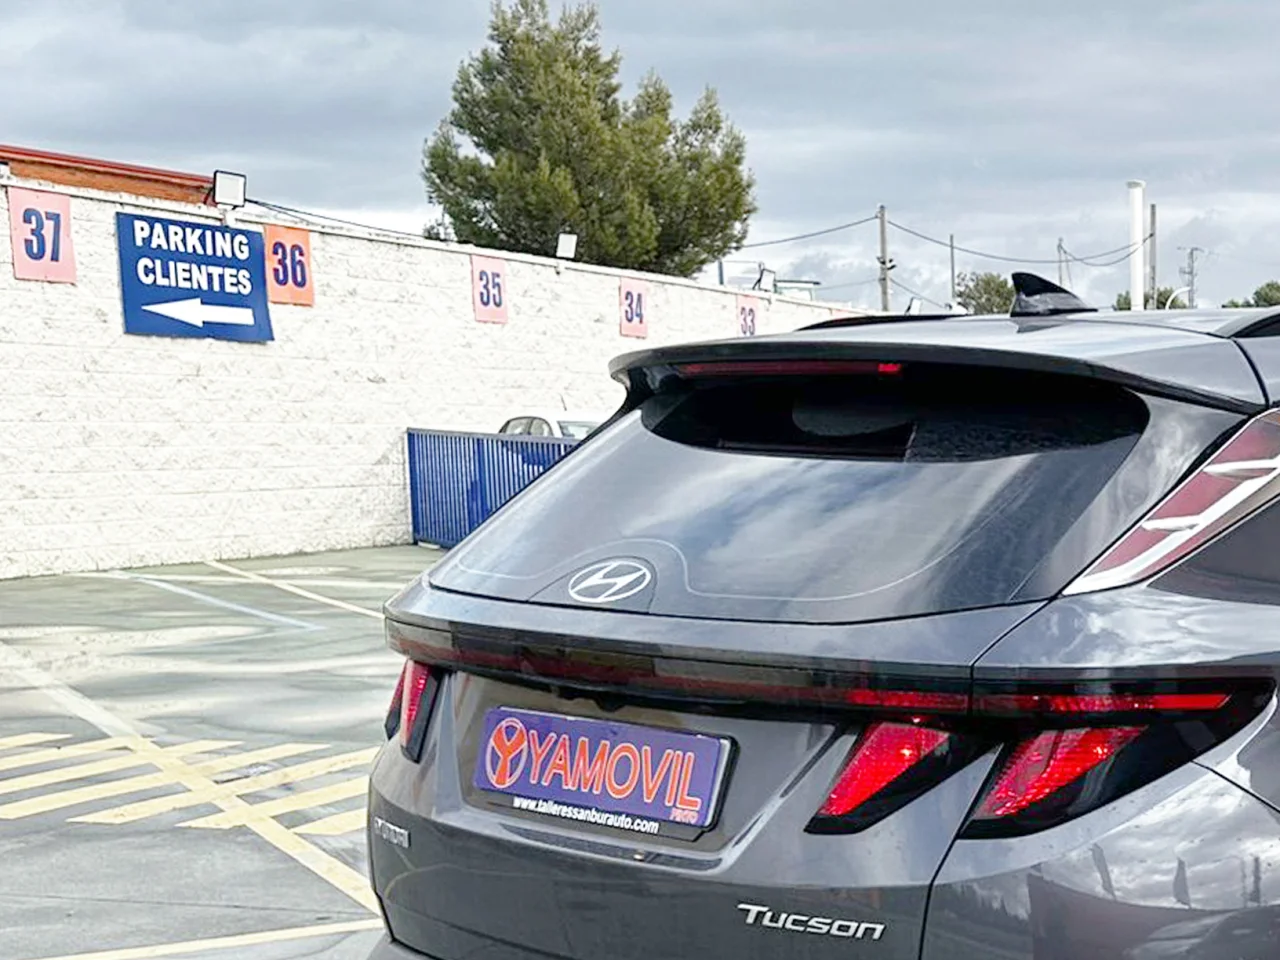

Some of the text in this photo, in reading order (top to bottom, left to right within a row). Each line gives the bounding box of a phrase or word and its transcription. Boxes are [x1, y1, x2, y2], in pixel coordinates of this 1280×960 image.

[23, 208, 61, 262] 37
[133, 219, 250, 260] PARKING
[136, 258, 252, 295] CLIENTES
[272, 242, 306, 287] 36
[479, 270, 502, 308] 35
[624, 291, 643, 325] 34
[740, 307, 756, 336] 33
[529, 729, 701, 809] YAMOVIL
[512, 796, 659, 835] www.talleressanburauto.com
